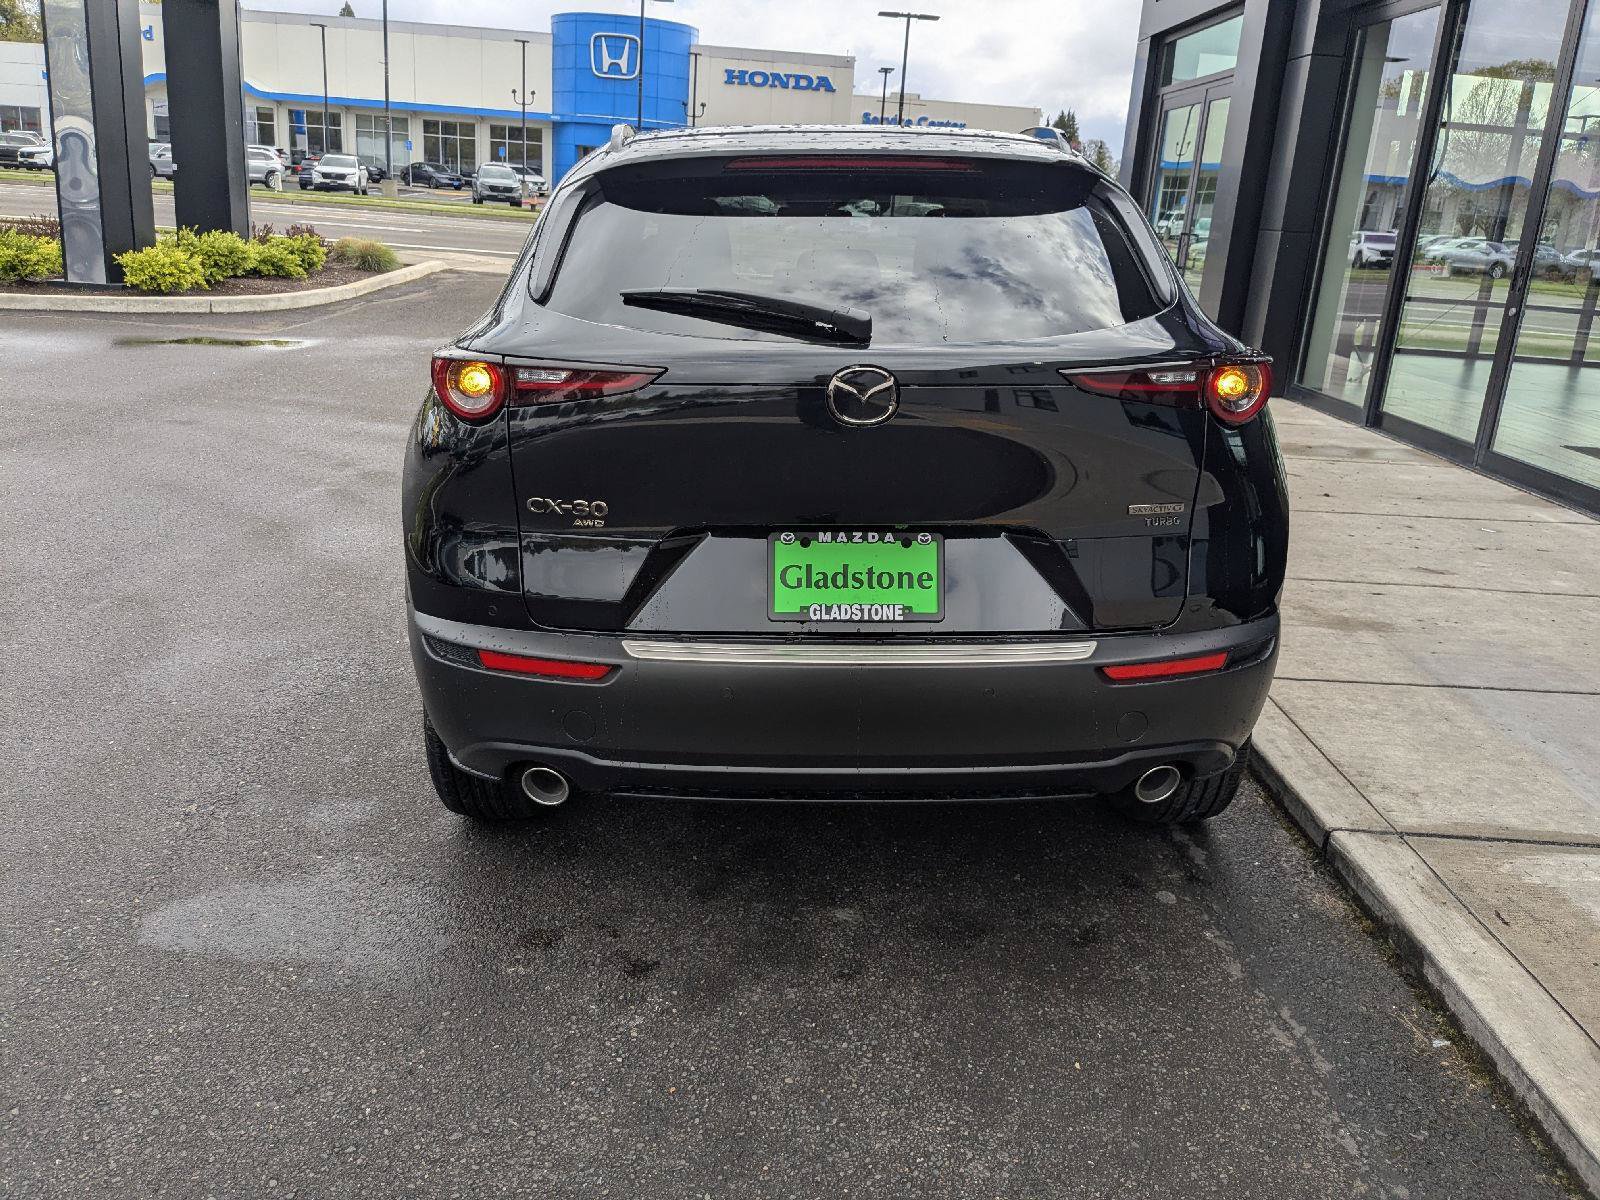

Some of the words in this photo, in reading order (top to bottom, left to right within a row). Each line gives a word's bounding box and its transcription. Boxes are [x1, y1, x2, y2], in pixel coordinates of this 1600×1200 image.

[724, 68, 837, 93] HONDA
[862, 112, 913, 126] Servie
[917, 116, 967, 128] Center
[526, 497, 609, 517] CX-30
[572, 518, 605, 528] AWD
[818, 531, 896, 543] MAZDA
[779, 563, 934, 590] Gladstone
[809, 603, 904, 621] GLADSTONE
